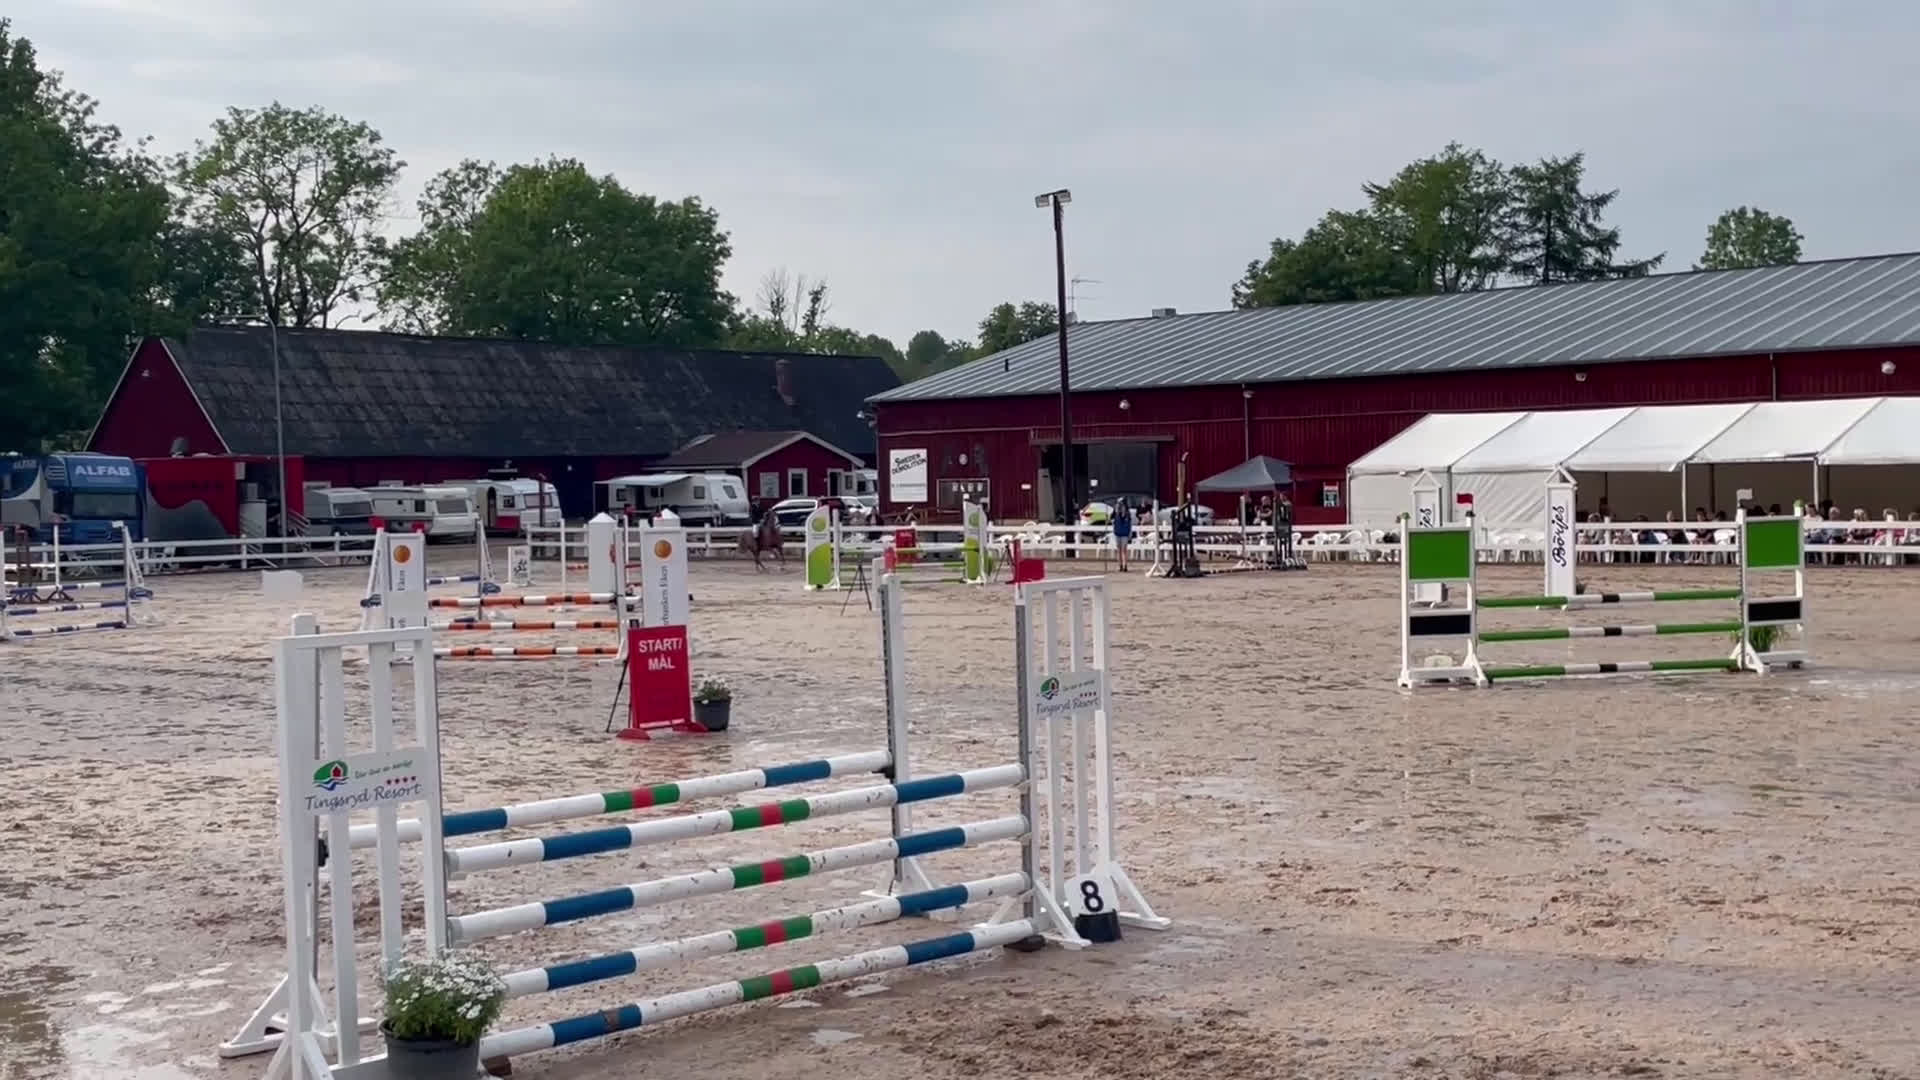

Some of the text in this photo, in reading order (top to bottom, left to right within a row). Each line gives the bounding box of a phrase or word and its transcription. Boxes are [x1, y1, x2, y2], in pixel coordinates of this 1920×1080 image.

[75, 464, 131, 477] ALFAB
[892, 458, 927, 475] DEMOLITION
[1552, 504, 1569, 568] Börjes
[638, 637, 683, 653] START/
[648, 653, 676, 671] MÅL
[304, 783, 423, 812] Tingsryd Resort
[1080, 880, 1104, 913] 8
